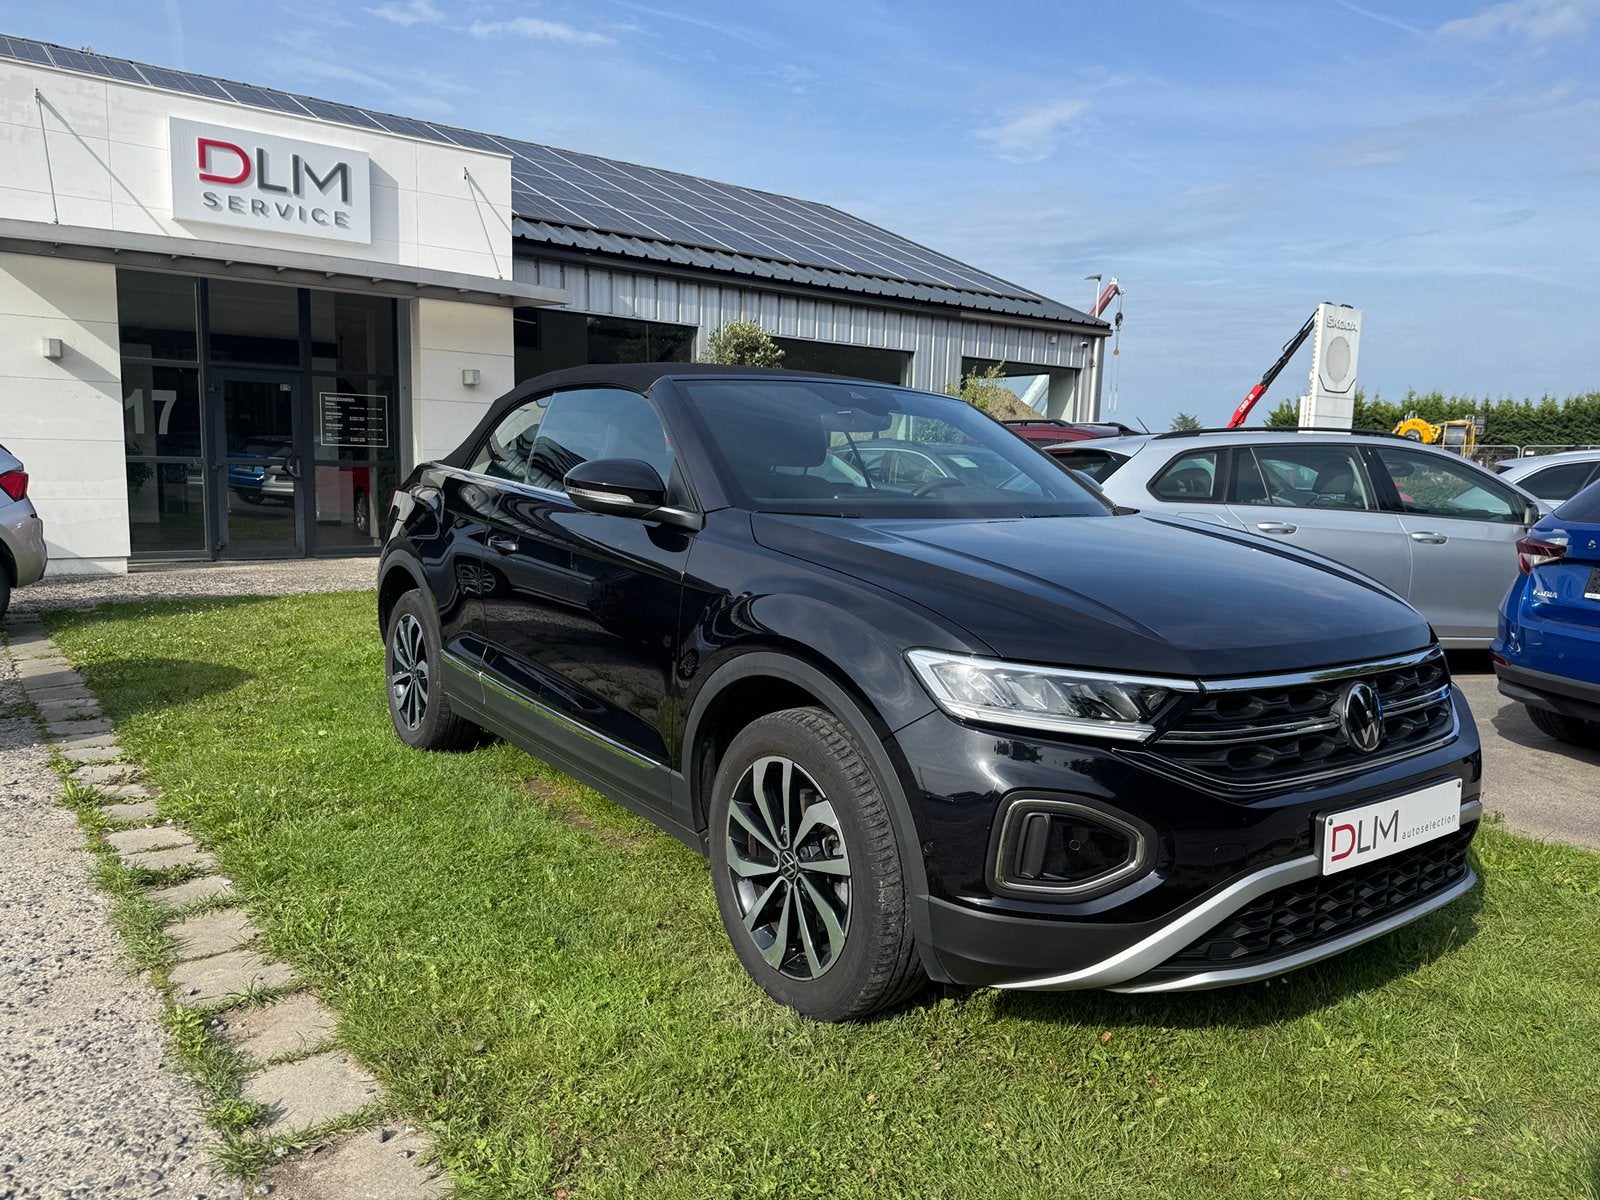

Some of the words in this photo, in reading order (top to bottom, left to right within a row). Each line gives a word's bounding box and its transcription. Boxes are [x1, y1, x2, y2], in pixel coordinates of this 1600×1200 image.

[197, 137, 349, 203] DLM
[203, 191, 350, 228] SERVICE
[125, 388, 177, 435] 17
[1331, 809, 1400, 862] DLM
[1401, 813, 1456, 840] autoselection
